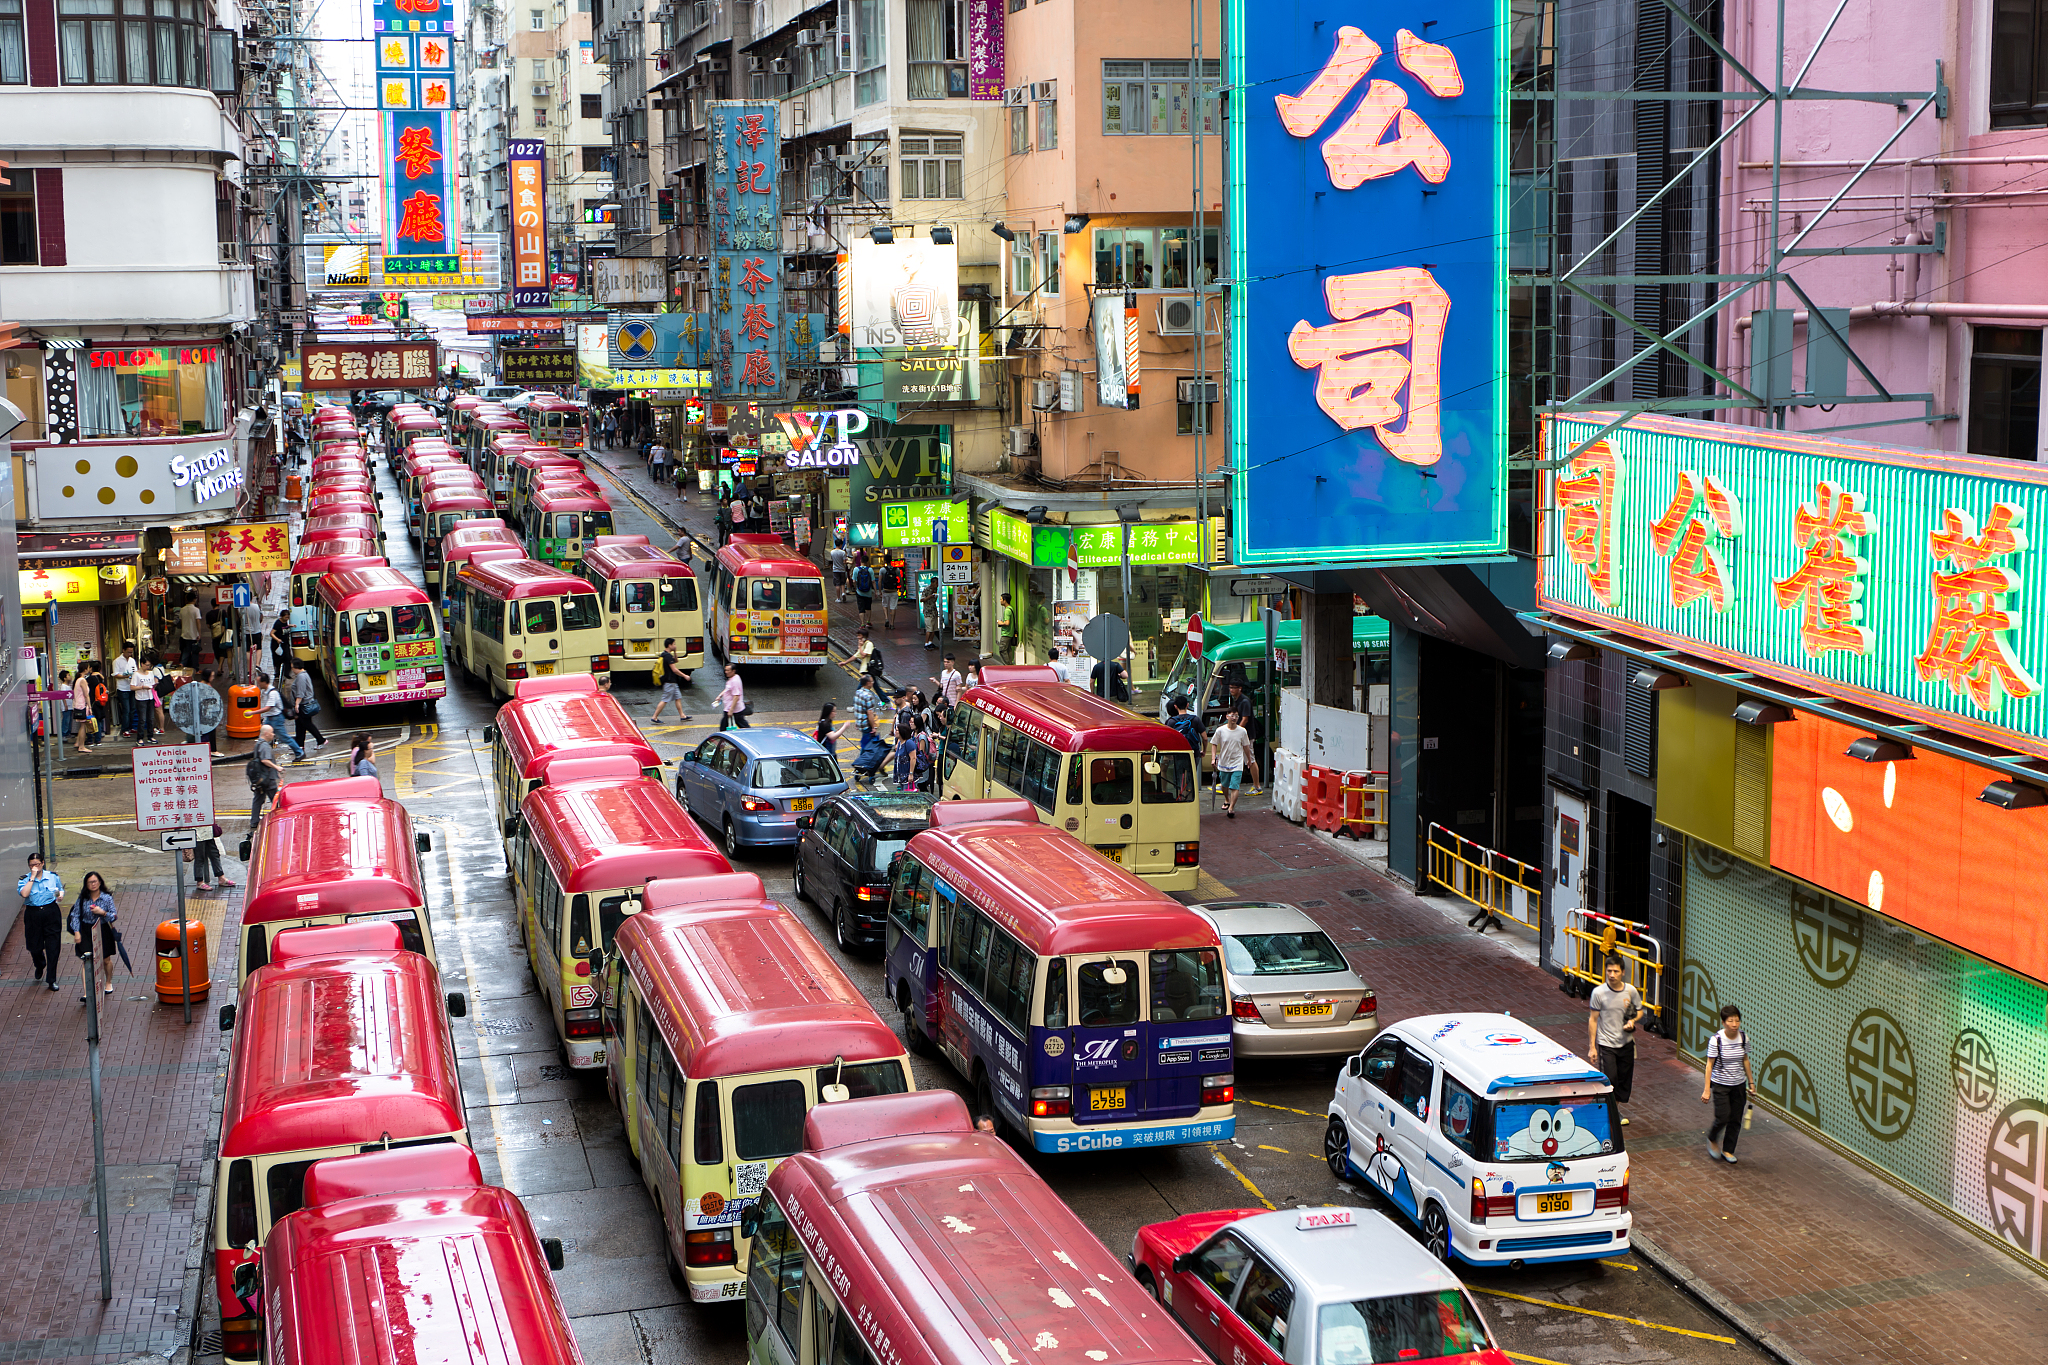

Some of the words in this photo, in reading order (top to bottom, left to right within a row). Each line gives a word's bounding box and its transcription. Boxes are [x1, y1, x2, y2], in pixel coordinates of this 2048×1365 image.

[508, 144, 544, 156] 1027
[735, 113, 772, 194] 澤記
[395, 126, 444, 243] 餐廳
[517, 166, 541, 284] 零食の山田
[1274, 25, 1464, 466] 公司
[327, 273, 369, 284] Nikon
[515, 292, 549, 304] 1027
[481, 320, 501, 328] 1027
[738, 256, 776, 387] 茶餐廳
[866, 327, 896, 345] INS
[902, 327, 950, 345] HAIR
[90, 350, 162, 368] SALON
[180, 347, 218, 364] MORE
[307, 350, 432, 380] 宏發燒臘
[900, 359, 963, 372] SALON
[773, 408, 869, 451] WP
[785, 448, 859, 467] SALON
[170, 447, 230, 487] SALON
[195, 466, 244, 504] MORE
[923, 502, 952, 515] 宏康
[60, 536, 111, 544] TONG
[209, 526, 286, 556] 海天堂
[948, 572, 966, 580] 全日
[1055, 606, 1068, 614] INS
[1069, 606, 1089, 614] HAIR
[383, 692, 404, 701] 2382
[406, 690, 427, 699] 2773
[156, 749, 187, 757] Vehicle
[141, 758, 174, 767] waiting
[148, 766, 197, 775] prosecuted
[138, 775, 172, 784] without
[174, 774, 208, 782] warning
[150, 785, 198, 797] 停車等候
[151, 799, 199, 812] 會被檢控
[146, 812, 206, 826] 而不予警告
[1286, 1006, 1301, 1015] MB
[1303, 1005, 1331, 1014] 8857
[1100, 1088, 1116, 1099] LU
[1092, 1098, 1125, 1109] 2799
[1057, 1133, 1123, 1152] S-Cube
[1132, 1130, 1176, 1145] 突破規限
[1181, 1125, 1222, 1139] 引領視界
[1540, 1200, 1570, 1212] 9190
[1306, 1212, 1351, 1227] TAXI
[785, 1193, 807, 1226] PUBLIC
[801, 1214, 819, 1244] LIGHT
[817, 1237, 829, 1262] BUS
[826, 1254, 834, 1271] 16
[832, 1264, 851, 1298] SEATS
